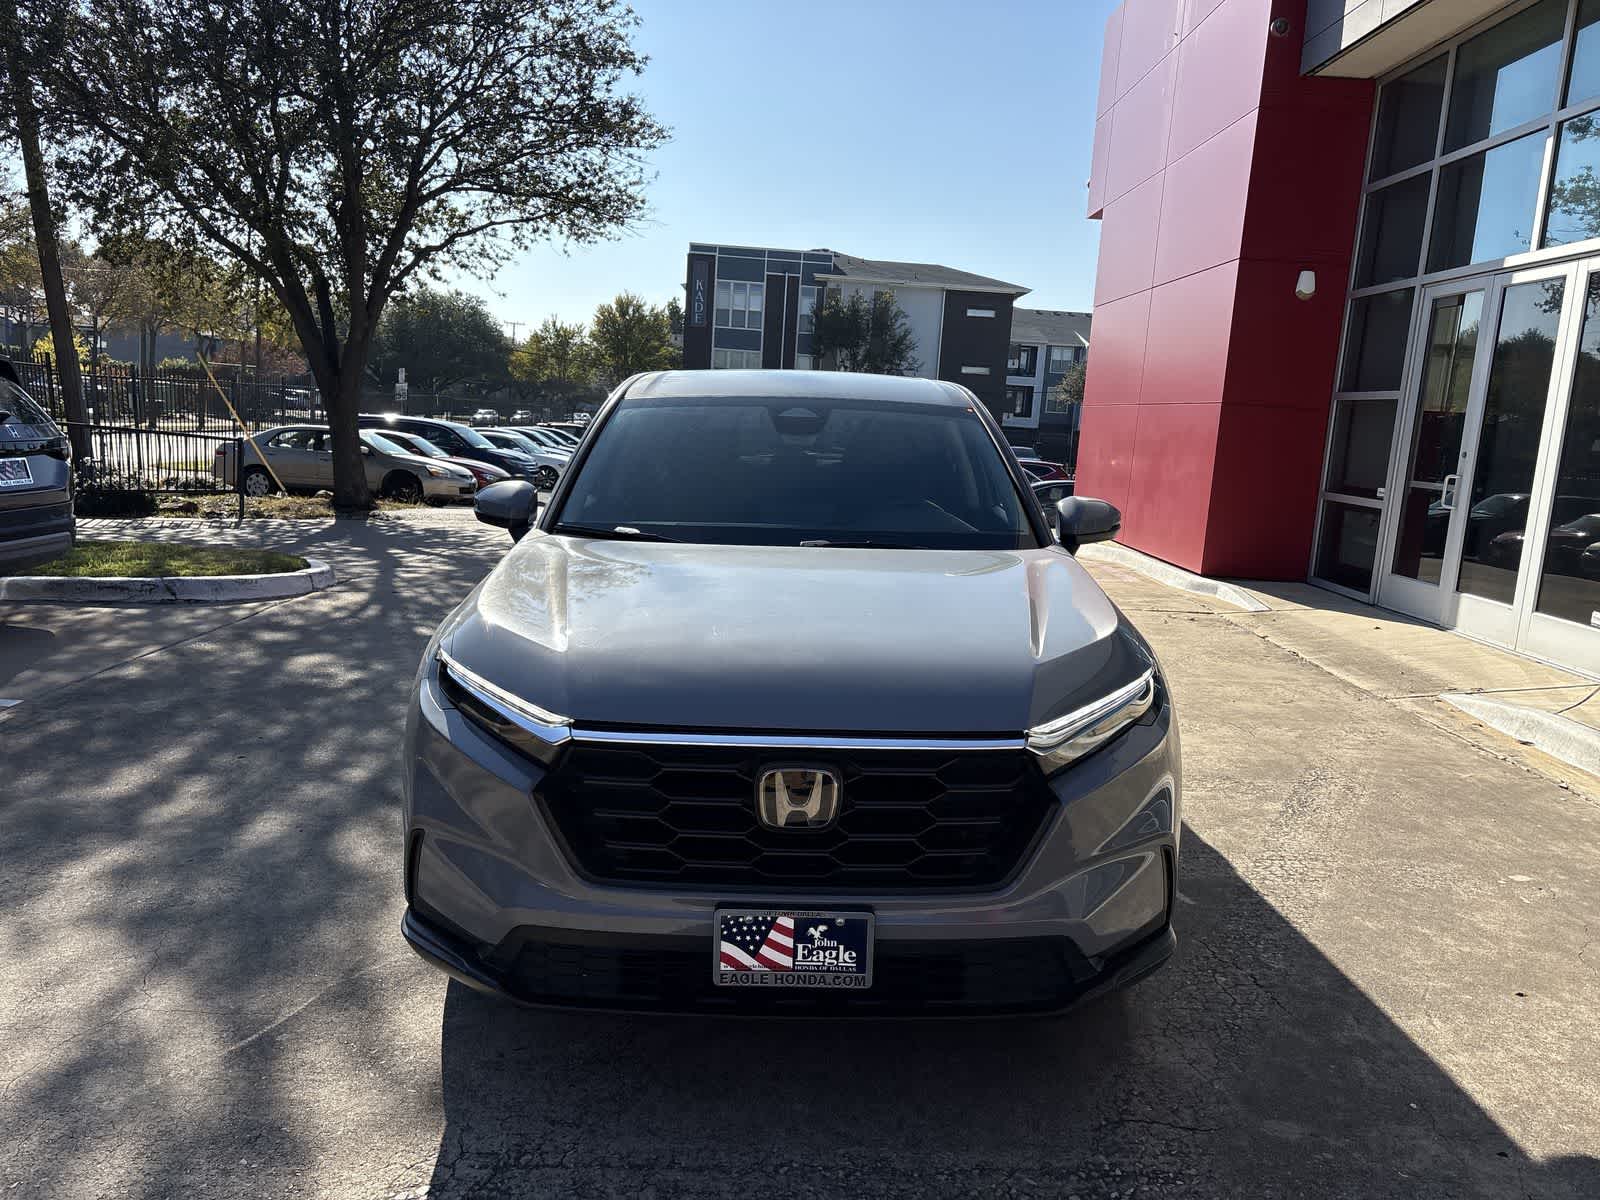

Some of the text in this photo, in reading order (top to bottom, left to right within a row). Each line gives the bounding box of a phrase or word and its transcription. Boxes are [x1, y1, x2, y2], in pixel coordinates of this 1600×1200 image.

[813, 938, 837, 949] John
[795, 943, 857, 966] Eagle
[719, 973, 866, 987] EAGLE HONDA.COM
